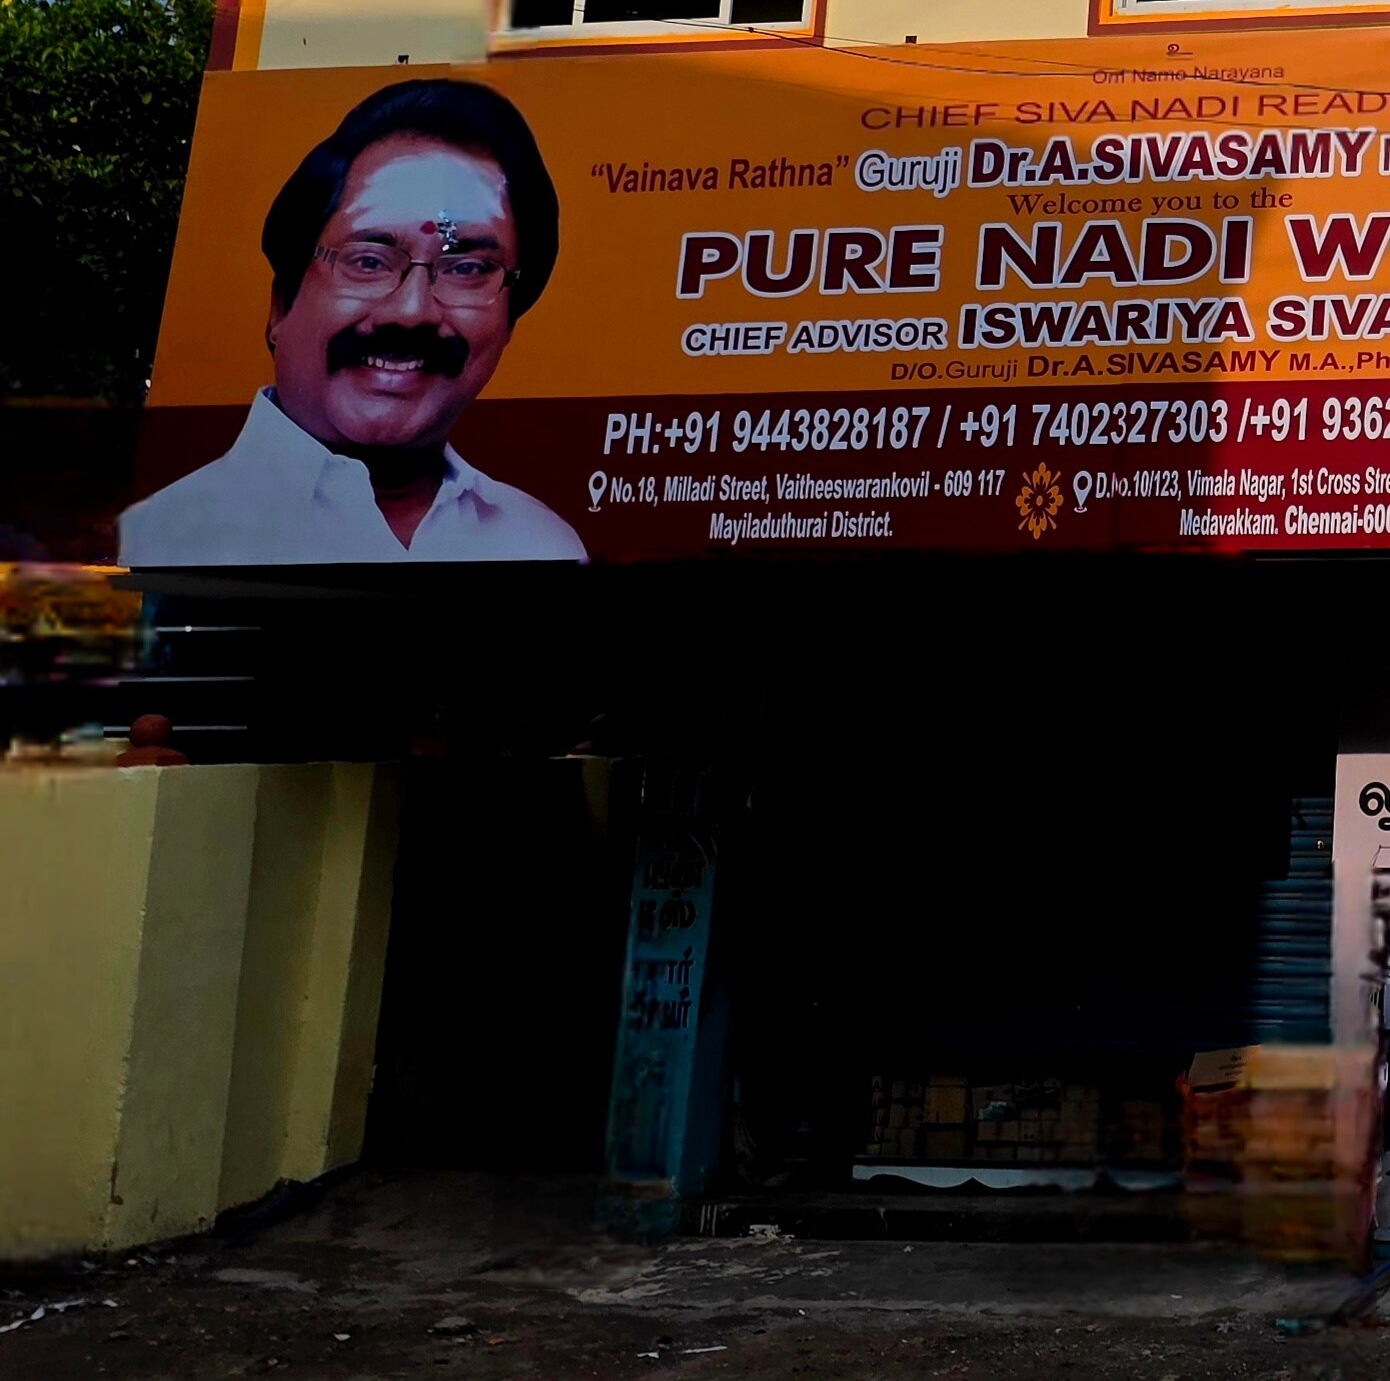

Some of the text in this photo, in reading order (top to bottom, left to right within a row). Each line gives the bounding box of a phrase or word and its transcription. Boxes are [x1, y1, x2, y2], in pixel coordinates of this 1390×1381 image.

[1194, 66, 1285, 81] Narayana
[861, 101, 999, 130] CHIEF
[1014, 99, 1115, 125] SIVA
[1130, 95, 1240, 120] NADI
[854, 146, 962, 198] Guruji
[966, 126, 1376, 188] Dr.A.SIVASAMY
[1007, 188, 1293, 217] Welcome you to the
[676, 224, 944, 299] PURE
[976, 216, 1253, 291] NADI
[681, 321, 785, 355] CHIEF
[787, 317, 947, 352] ADVISOR
[958, 297, 1253, 350] ISWARIYA
[891, 358, 1018, 383] D/O.Guruji
[1026, 349, 1280, 378] Dr.A.SIVASAMY
[603, 410, 721, 455] PH:+91
[732, 406, 931, 452] 9443828187
[960, 403, 1016, 447] +91
[1032, 398, 1228, 447] 7402327303
[663, 475, 715, 503] Milladi
[719, 473, 770, 504] Street,
[774, 470, 931, 501] Vaitheeswarankovil
[944, 470, 972, 497] 609
[977, 469, 1005, 496] 117
[1187, 470, 1236, 497] Vimala
[1239, 469, 1286, 500] Nagar,
[1290, 468, 1313, 494] 1st
[1316, 467, 1361, 494] Cross
[709, 510, 894, 545] Mayiladuthurai District.
[1179, 507, 1279, 536] Medavakkam.
